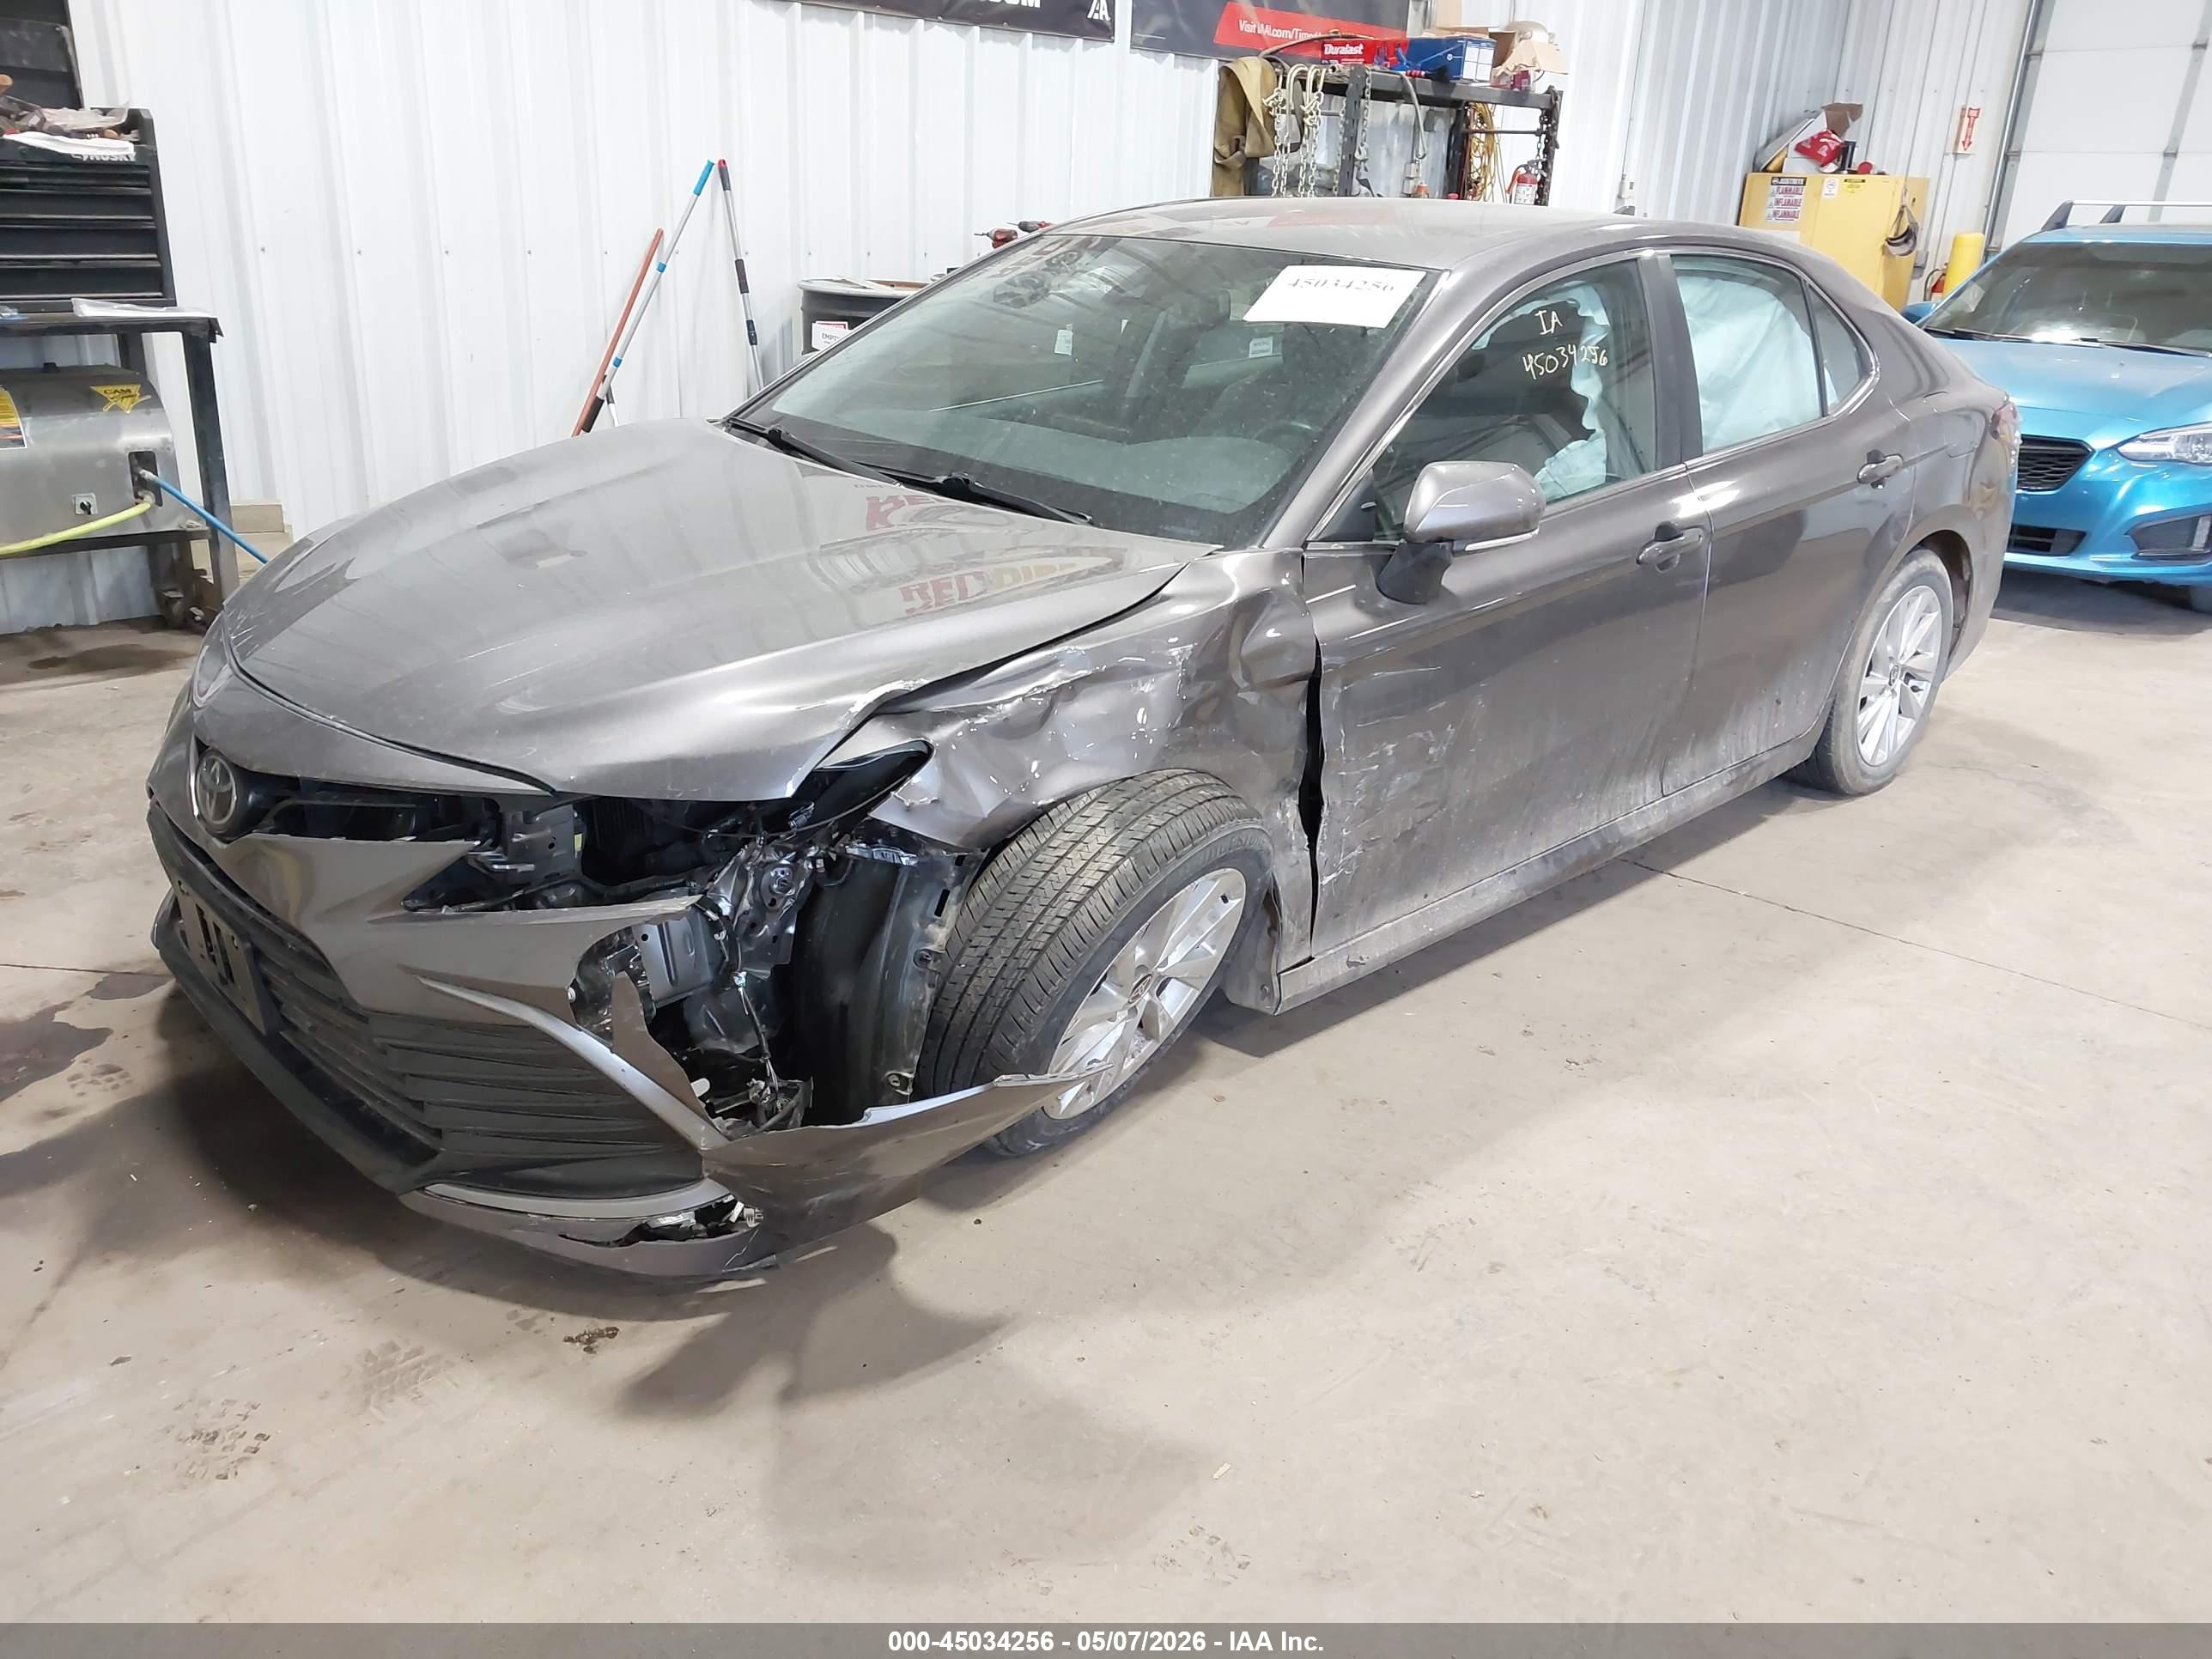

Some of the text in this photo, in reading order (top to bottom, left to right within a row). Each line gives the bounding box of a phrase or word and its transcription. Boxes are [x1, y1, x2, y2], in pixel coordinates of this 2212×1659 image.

[1238, 19, 1256, 33] Visit
[1323, 43, 1364, 56] Duralast
[1534, 309, 1563, 335] IA
[1522, 343, 1608, 380] 45034256
